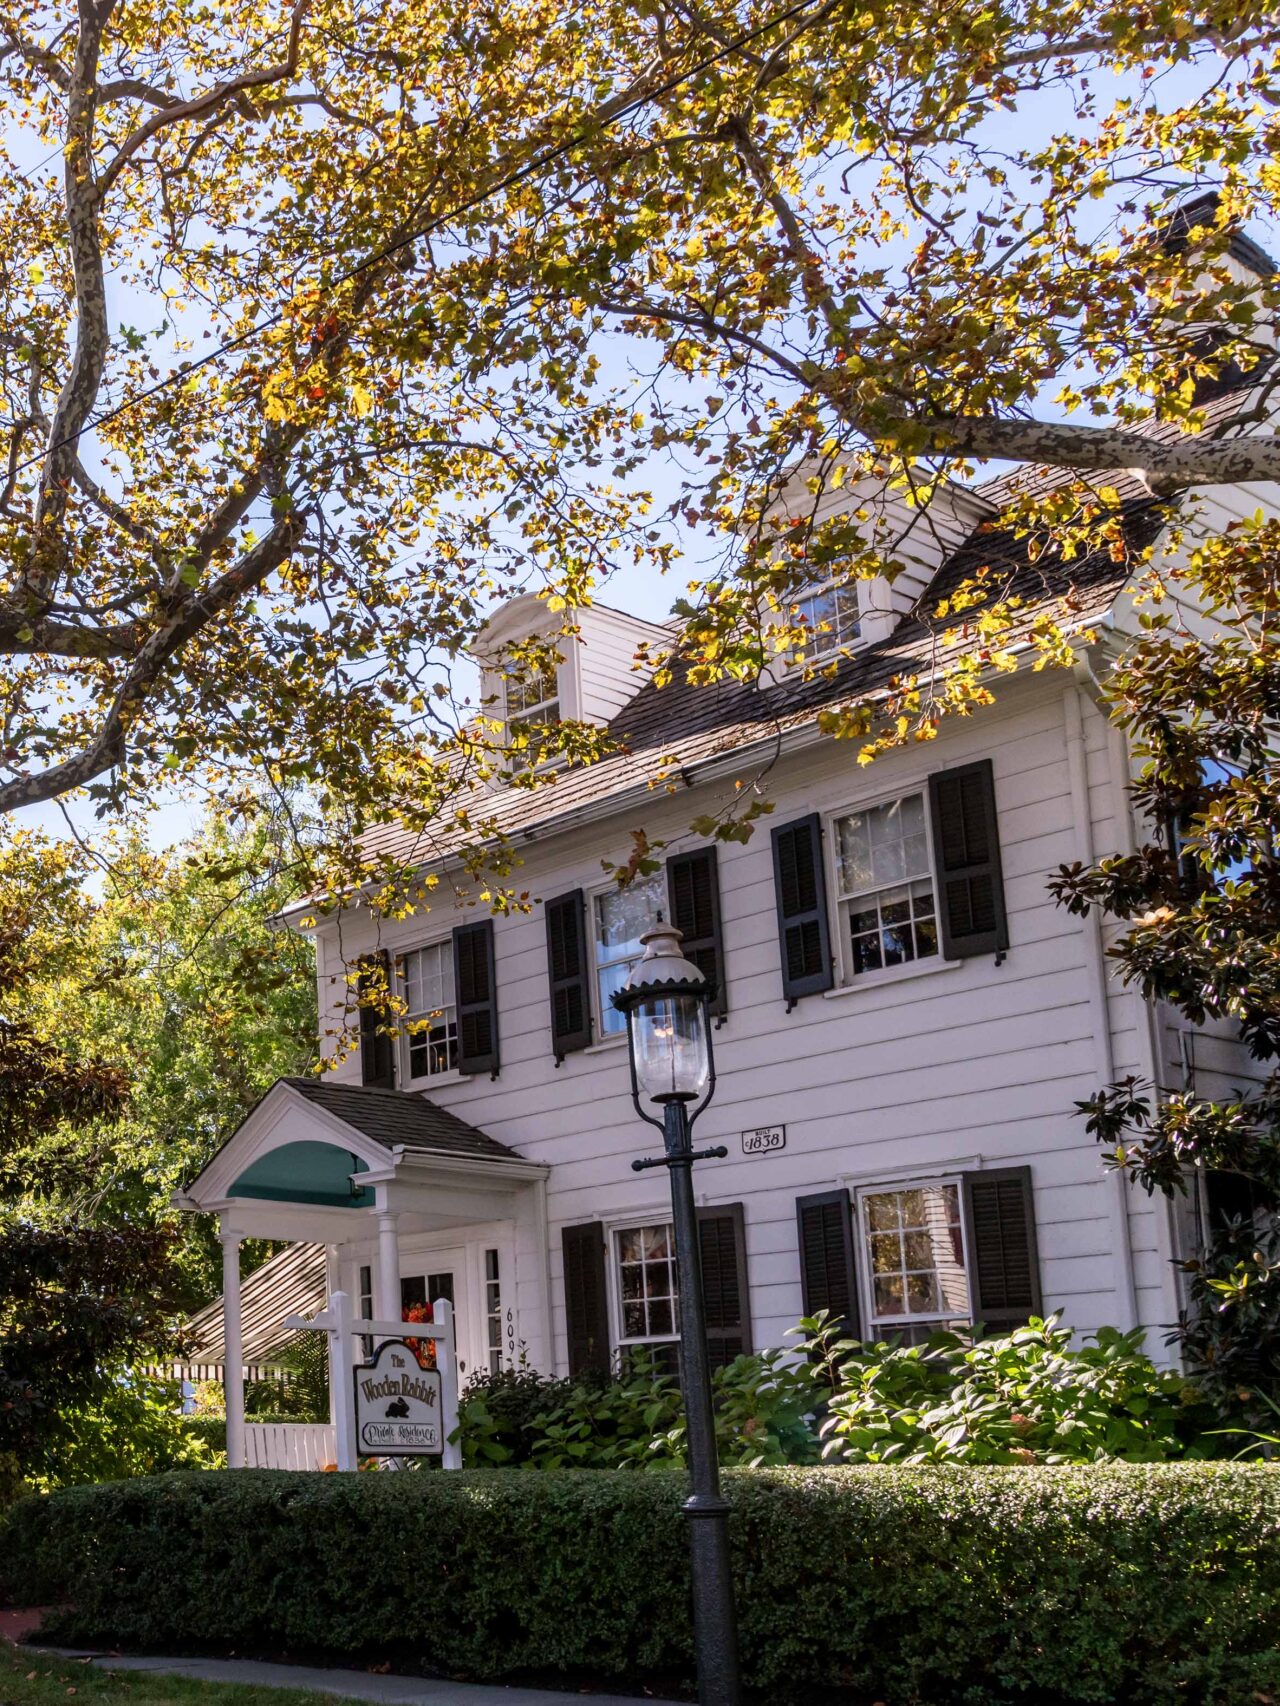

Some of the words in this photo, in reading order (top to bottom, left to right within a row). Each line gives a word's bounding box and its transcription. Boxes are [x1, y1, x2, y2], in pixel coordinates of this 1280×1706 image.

[755, 1128, 770, 1136] BUILT
[506, 1307, 515, 1355] 609
[390, 1354, 405, 1368] The
[360, 1374, 401, 1404] Wooden
[401, 1373, 437, 1408] Rabbit
